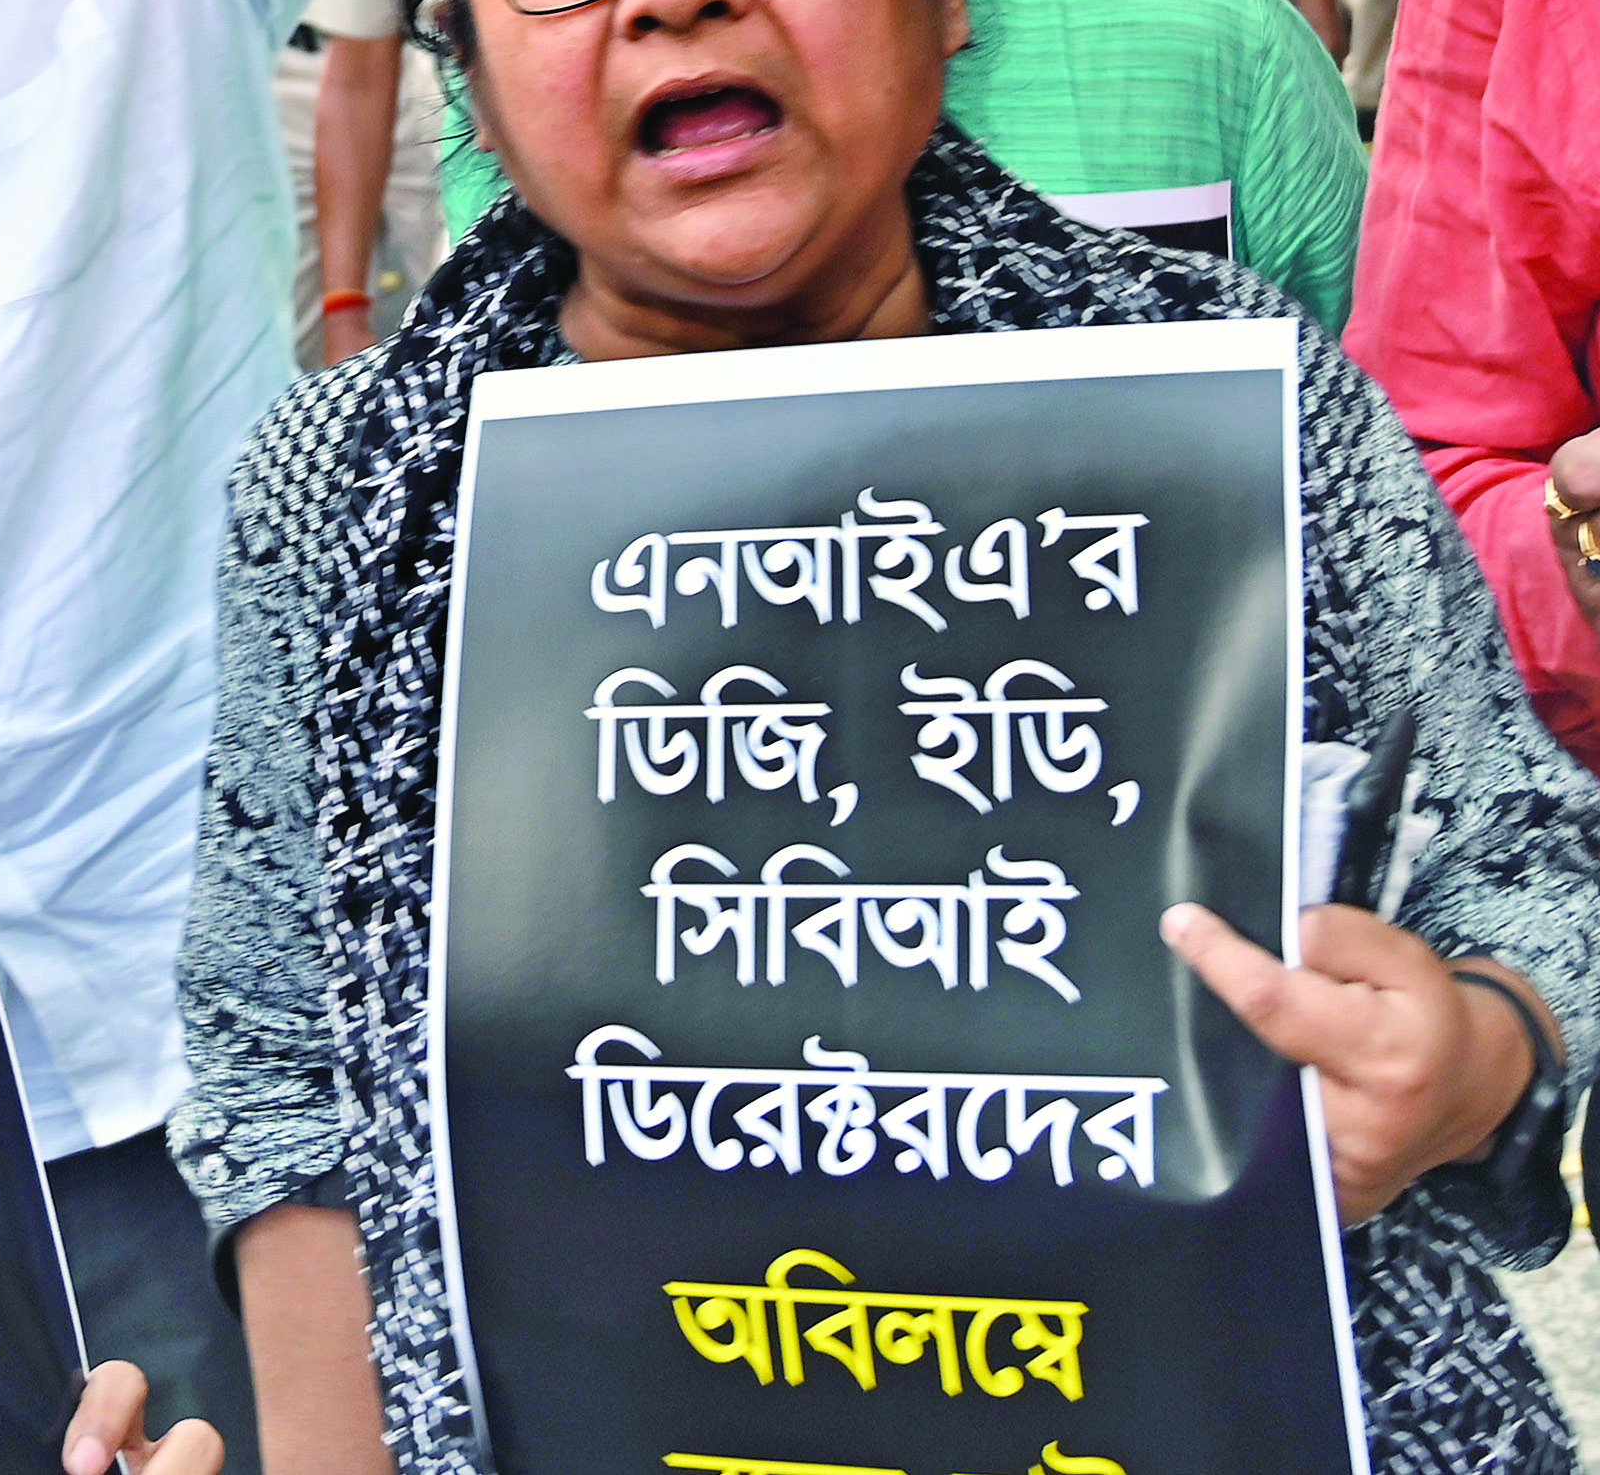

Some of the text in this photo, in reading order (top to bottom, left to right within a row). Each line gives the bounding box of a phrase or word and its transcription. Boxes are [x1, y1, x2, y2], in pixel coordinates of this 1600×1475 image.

[589, 487, 1149, 631] এনআইএ’র
[583, 660, 1139, 826] ডিজি, ইডি,
[640, 844, 1080, 1003] সিবিআই
[565, 1025, 1169, 1188] ডিরেক্টরদের
[664, 1249, 1089, 1401] অবিলম্বে
